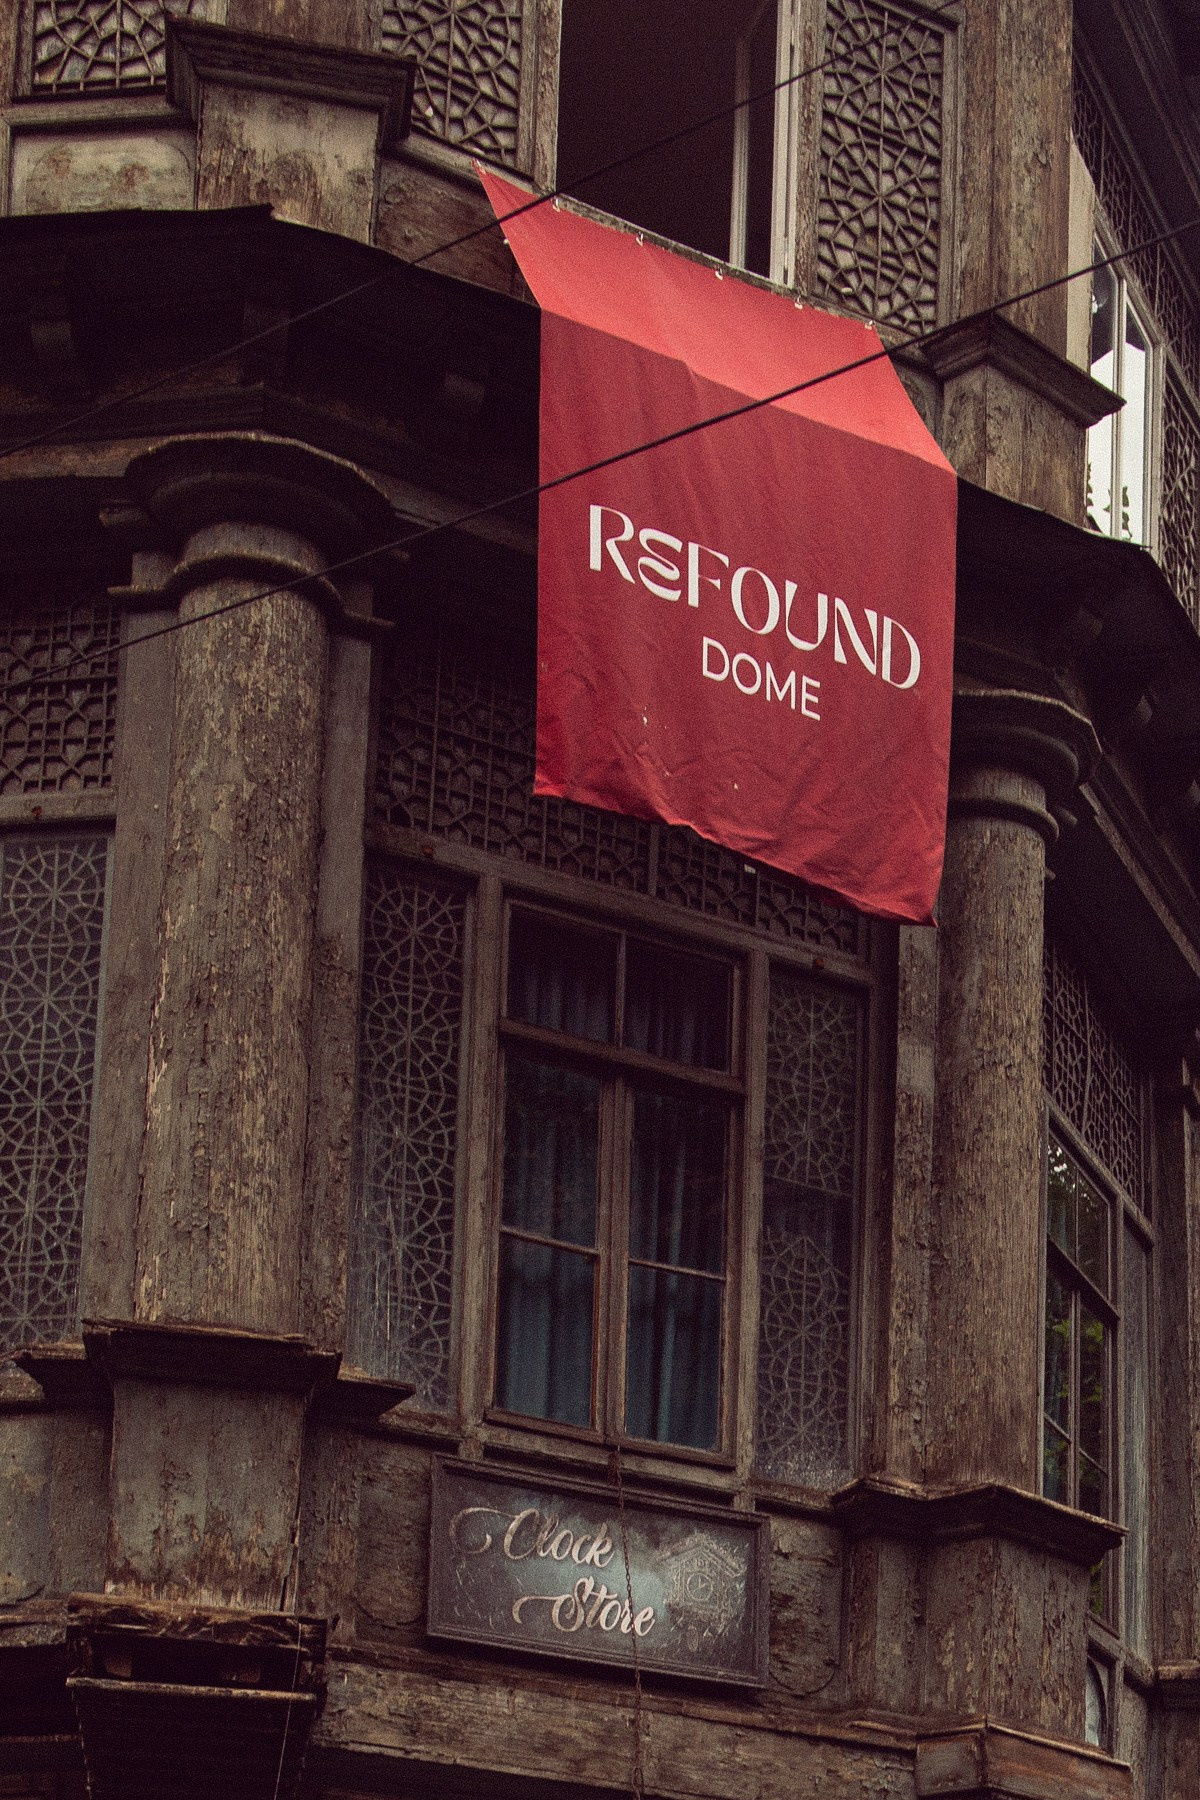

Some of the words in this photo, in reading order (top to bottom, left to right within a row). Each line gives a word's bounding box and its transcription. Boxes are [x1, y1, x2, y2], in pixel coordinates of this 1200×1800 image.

[589, 503, 921, 690] REFOUND
[702, 635, 821, 722] DOME
[450, 1506, 615, 1568] Clock
[512, 1575, 656, 1637] Store
